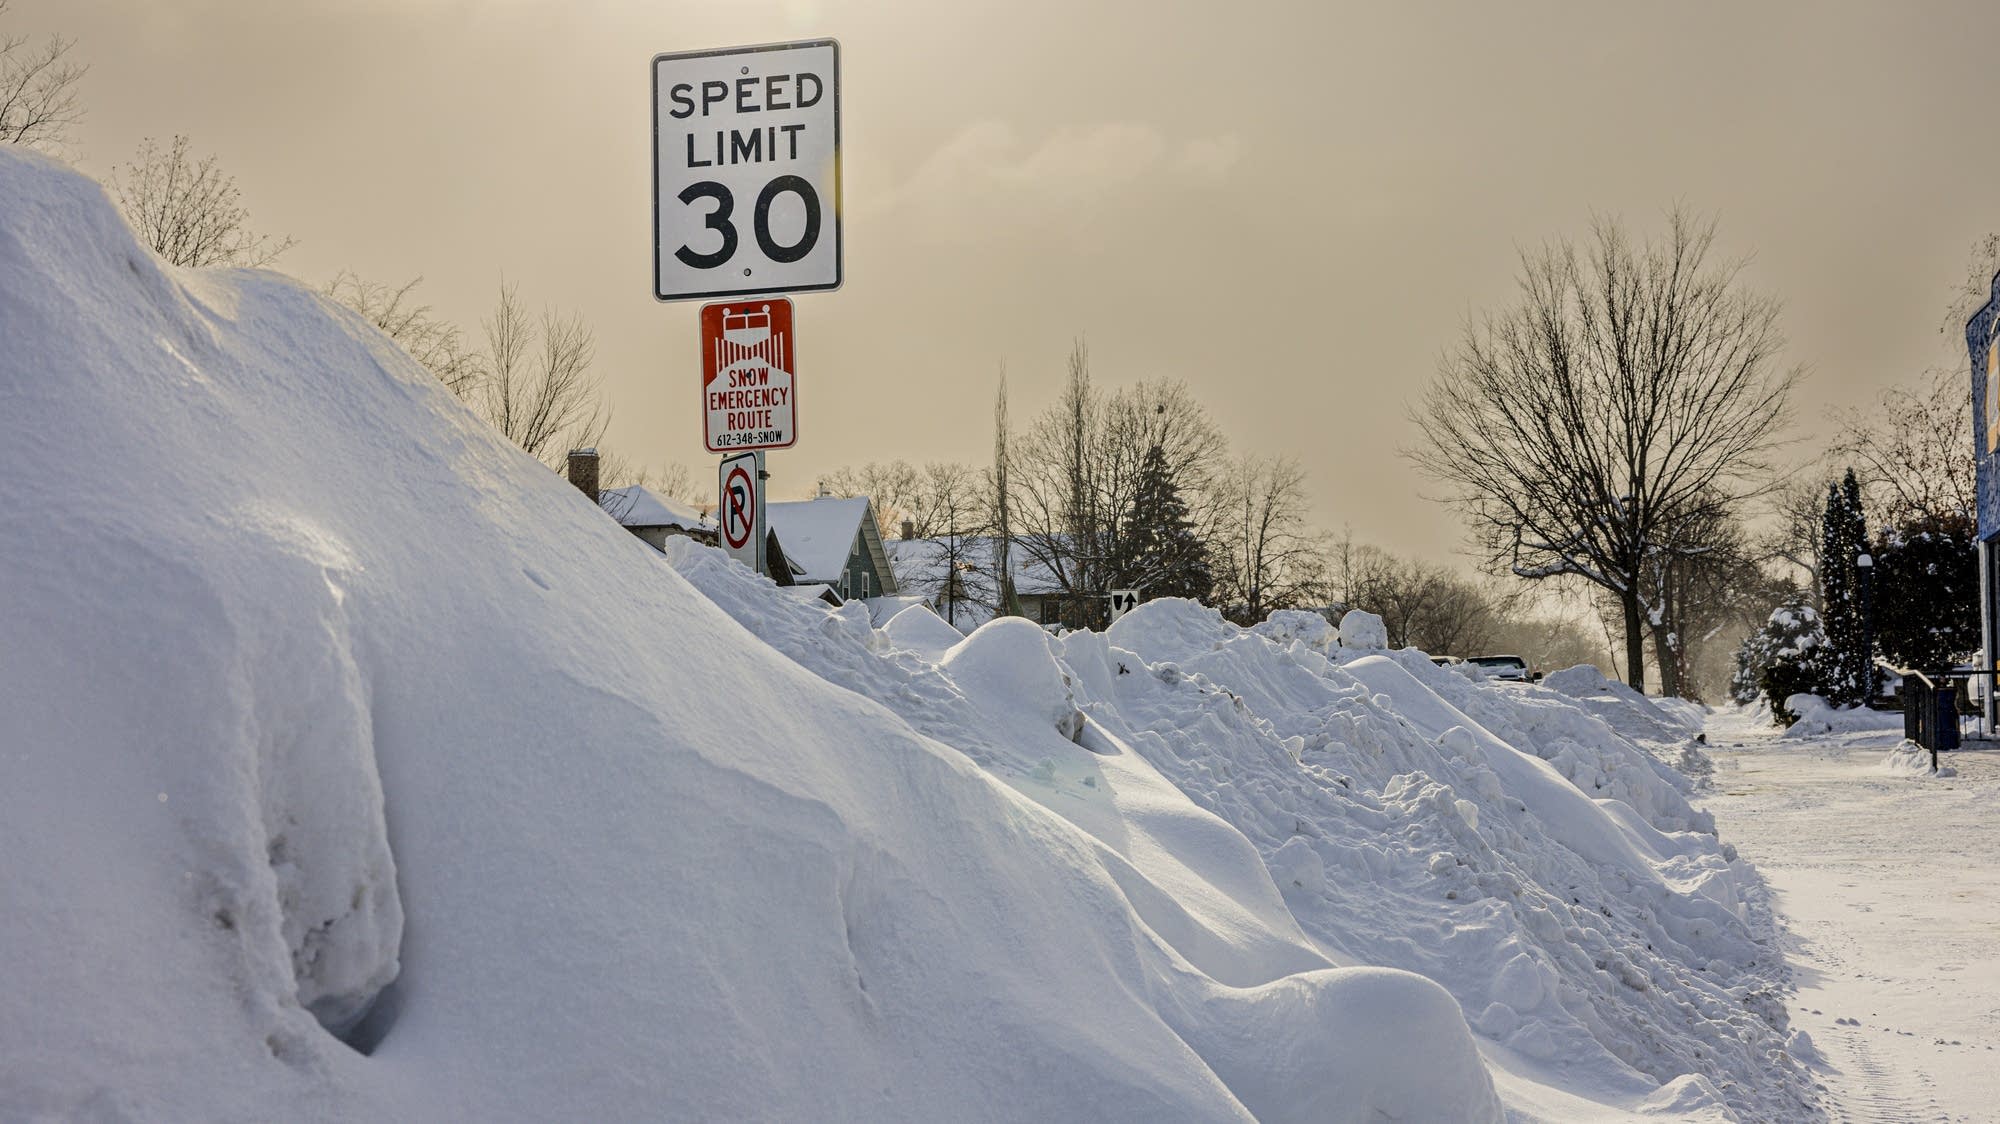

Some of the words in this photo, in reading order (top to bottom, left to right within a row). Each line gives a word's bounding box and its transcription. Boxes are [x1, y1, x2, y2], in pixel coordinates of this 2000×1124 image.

[669, 72, 823, 119] SPEED
[687, 124, 805, 168] LIMIT
[674, 174, 821, 269] 30
[729, 368, 768, 388] SNOW
[710, 387, 788, 411] EMERGENCY
[728, 410, 773, 431] ROUTE
[716, 430, 782, 446] 612-348-SNOW
